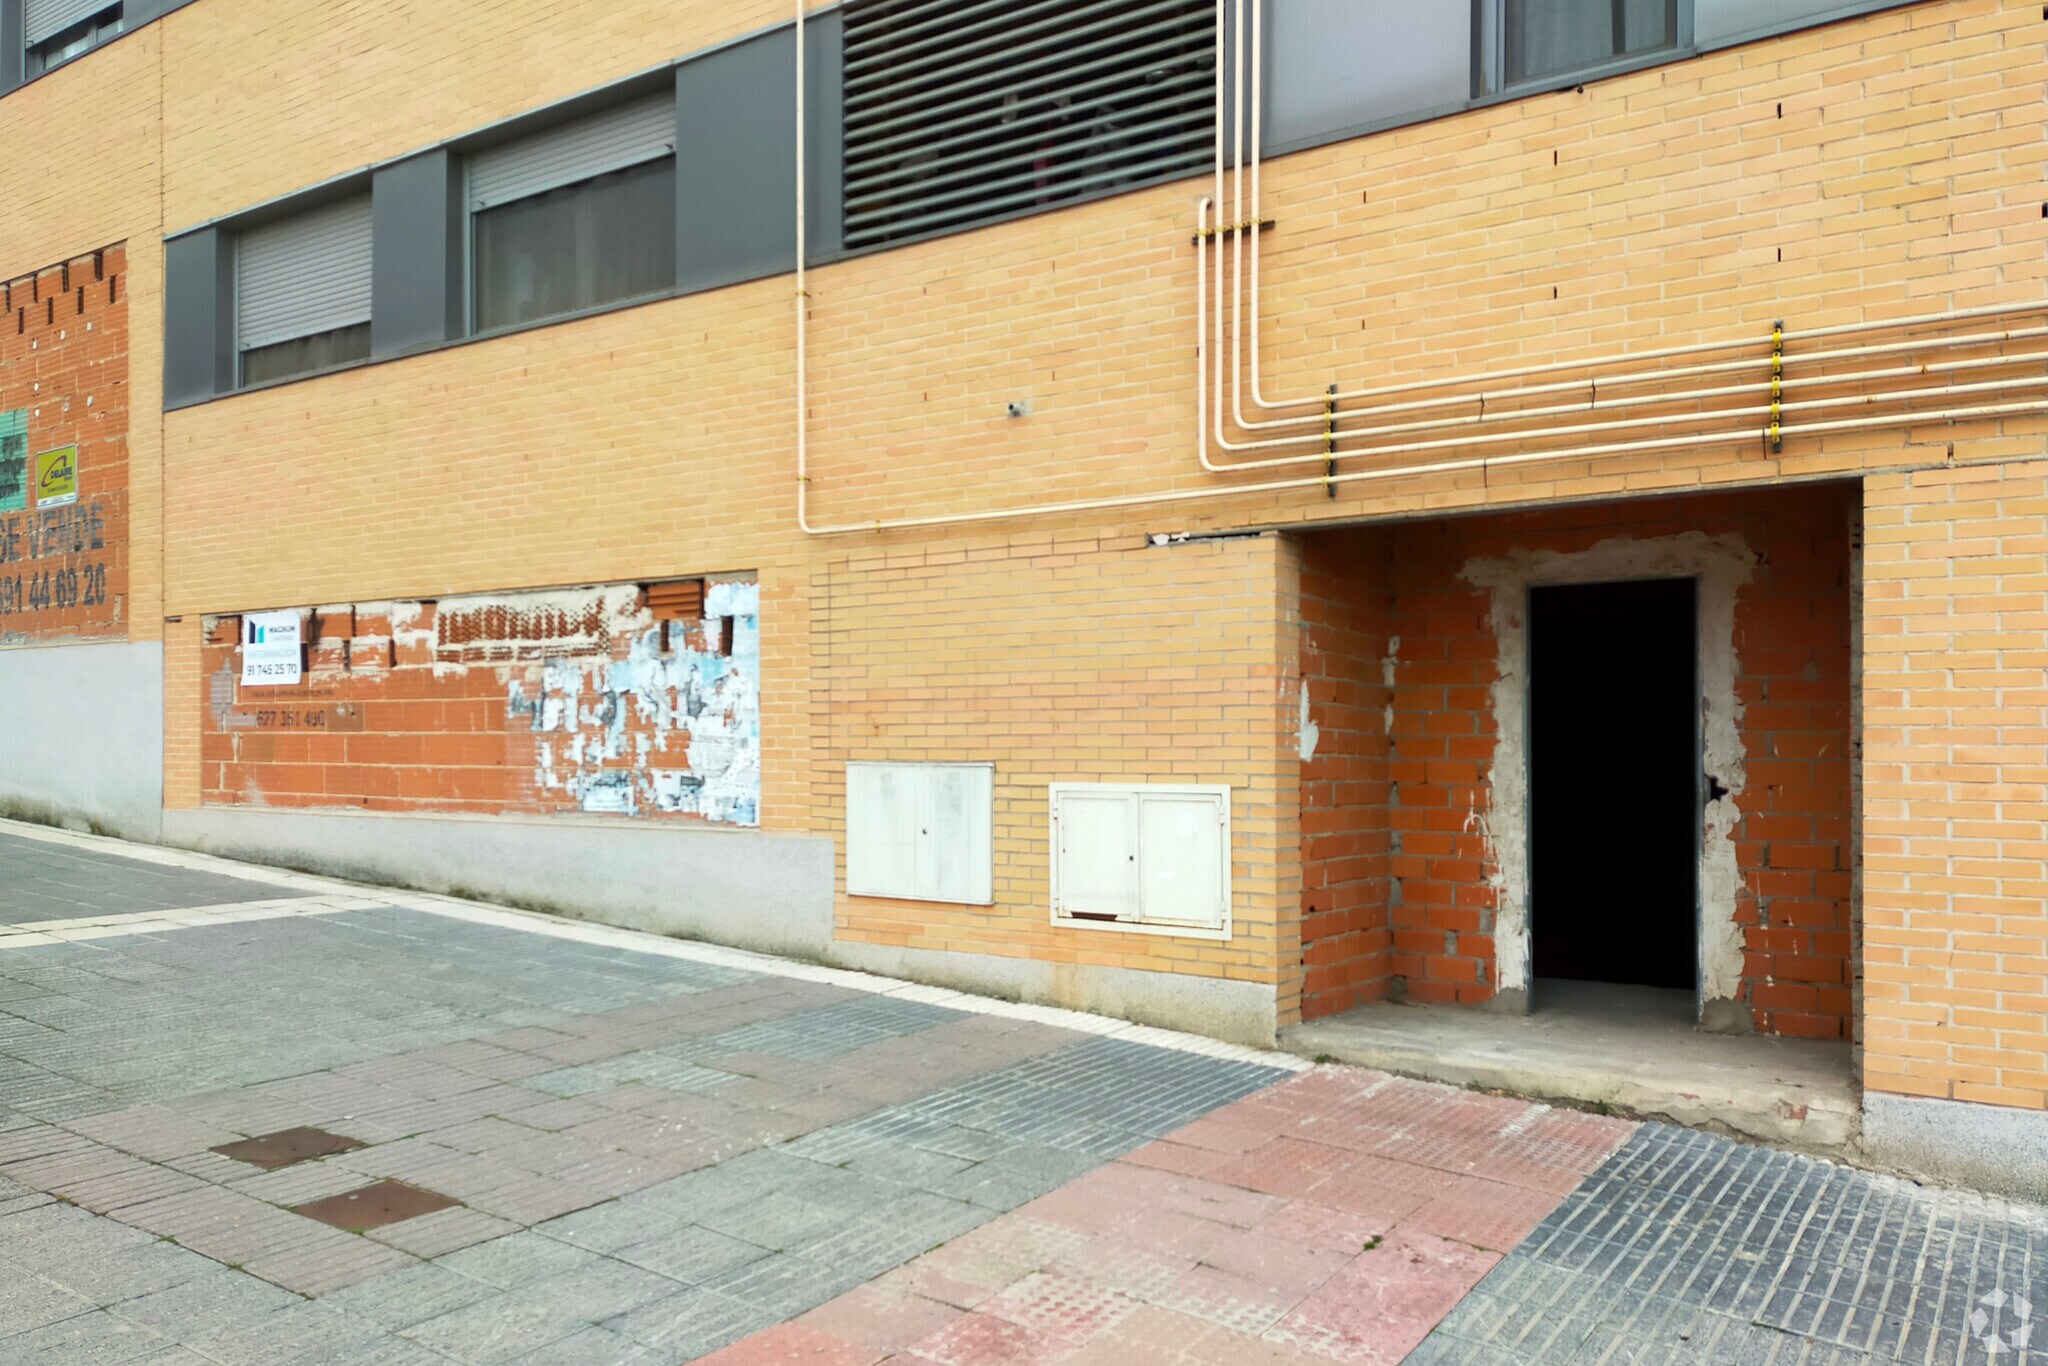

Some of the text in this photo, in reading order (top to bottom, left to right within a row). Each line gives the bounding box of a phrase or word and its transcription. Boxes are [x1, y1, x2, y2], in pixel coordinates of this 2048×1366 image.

[28, 503, 104, 559] VENDE
[29, 571, 50, 611] 44
[56, 567, 78, 609] 69
[84, 562, 106, 605] 20
[247, 663, 297, 676] 91 745 25 70
[257, 710, 277, 726] 627
